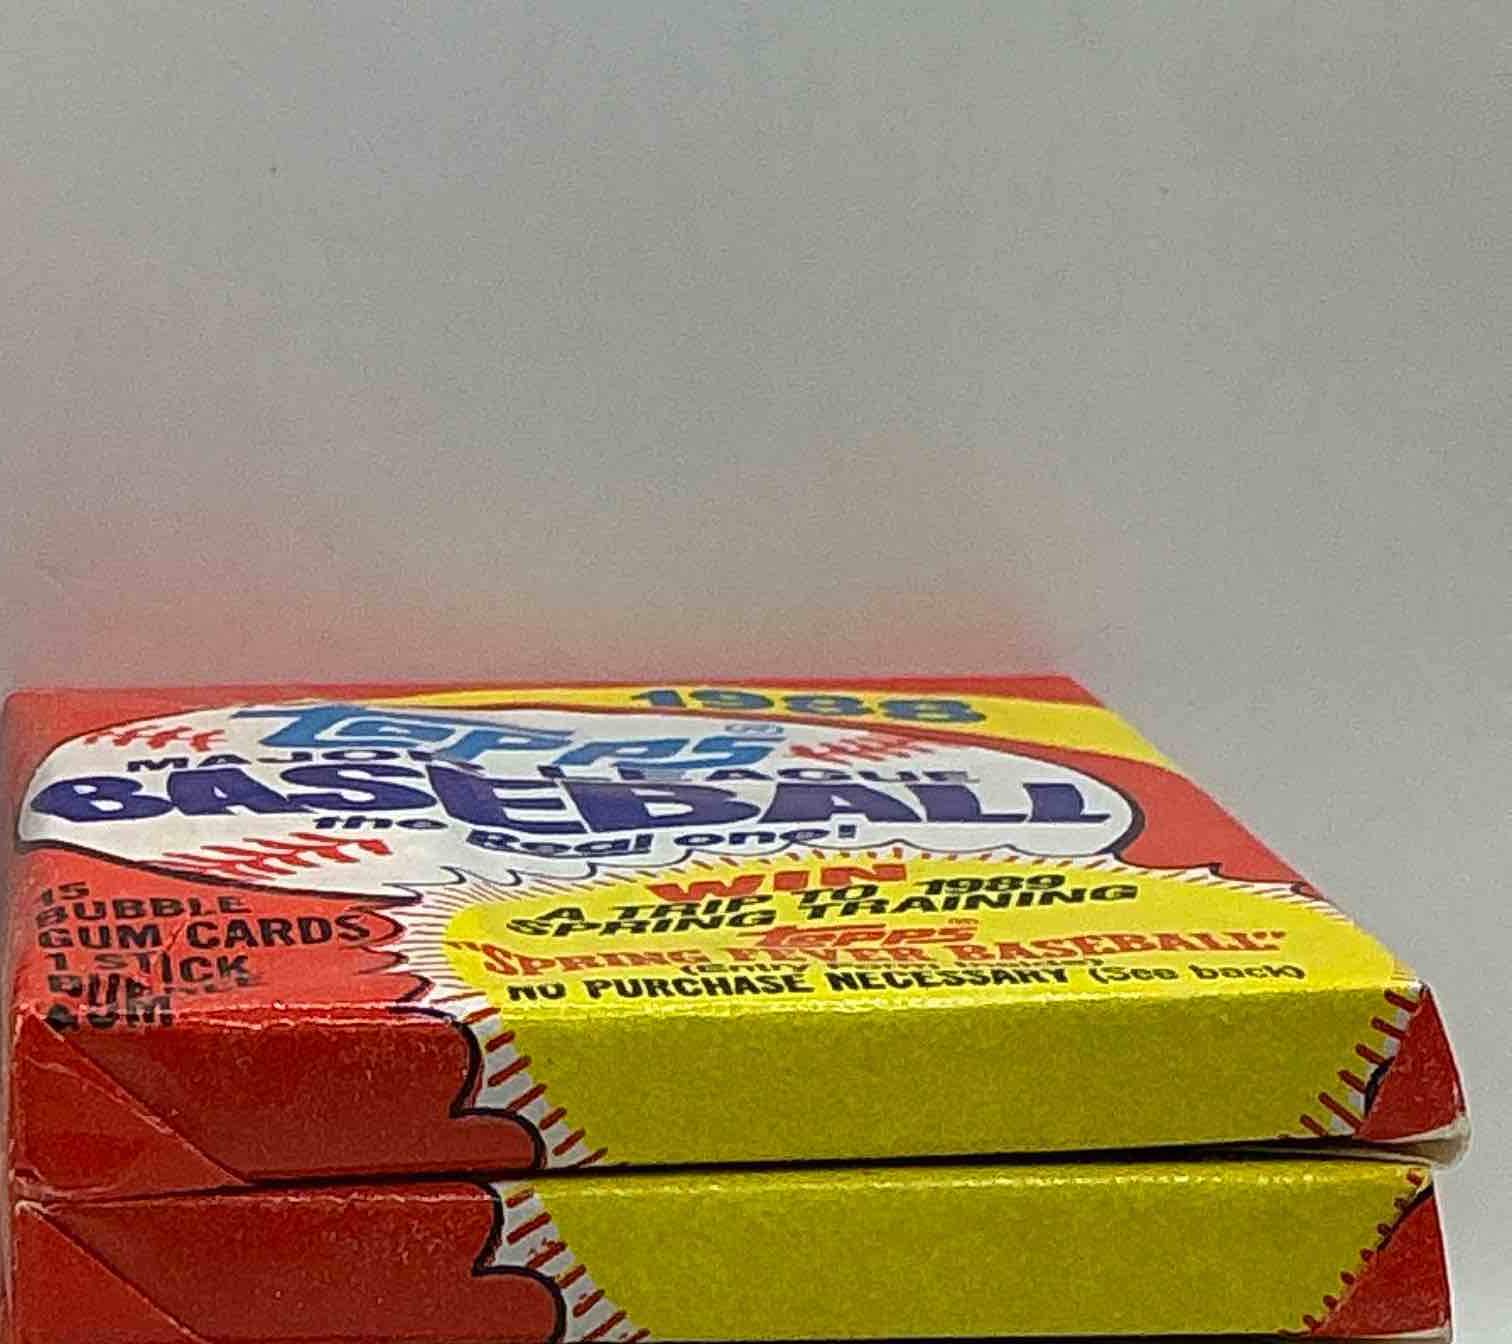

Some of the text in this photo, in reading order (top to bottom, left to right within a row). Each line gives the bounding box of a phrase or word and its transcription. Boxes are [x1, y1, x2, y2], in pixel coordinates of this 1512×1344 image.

[631, 689, 986, 723] 1988
[29, 762, 1112, 832] BASEBALL
[313, 815, 448, 829] the
[466, 829, 654, 855] Real
[39, 881, 89, 906] 15
[646, 863, 907, 902] WIN
[36, 895, 252, 928] BUBBLE
[506, 885, 1138, 937] SPRING TRAINING
[533, 906, 586, 922] A
[608, 894, 772, 921] TRIP
[799, 883, 878, 904] TO
[38, 913, 371, 949] GUM CARDS
[47, 950, 260, 986] 1 STICK
[506, 983, 568, 1001] NO
[582, 974, 815, 999] PURCHASE
[824, 968, 1069, 991] NECESSARY
[1088, 964, 1178, 984] (See
[1190, 964, 1306, 981] back)
